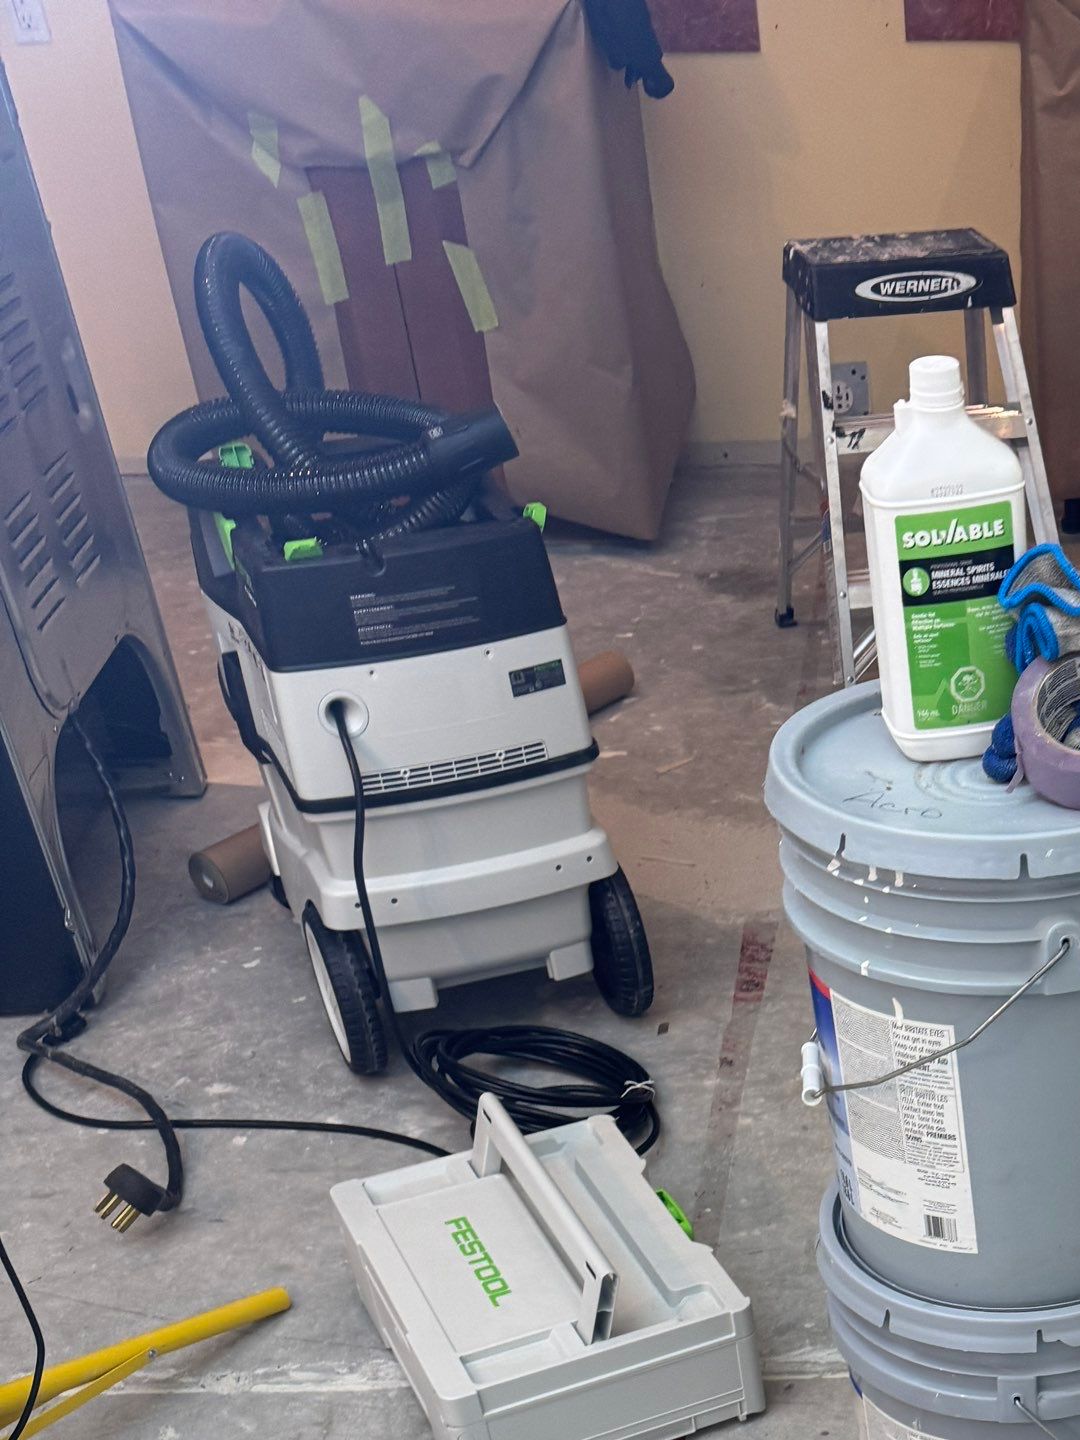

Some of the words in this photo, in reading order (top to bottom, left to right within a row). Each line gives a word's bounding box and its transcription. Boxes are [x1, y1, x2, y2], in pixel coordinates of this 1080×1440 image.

[879, 278, 954, 296] WERNER
[902, 517, 1005, 549] SOLVABLE
[931, 568, 965, 580] MINERAL
[966, 561, 995, 576] SPIRITS
[444, 1216, 512, 1308] FESTOOL
